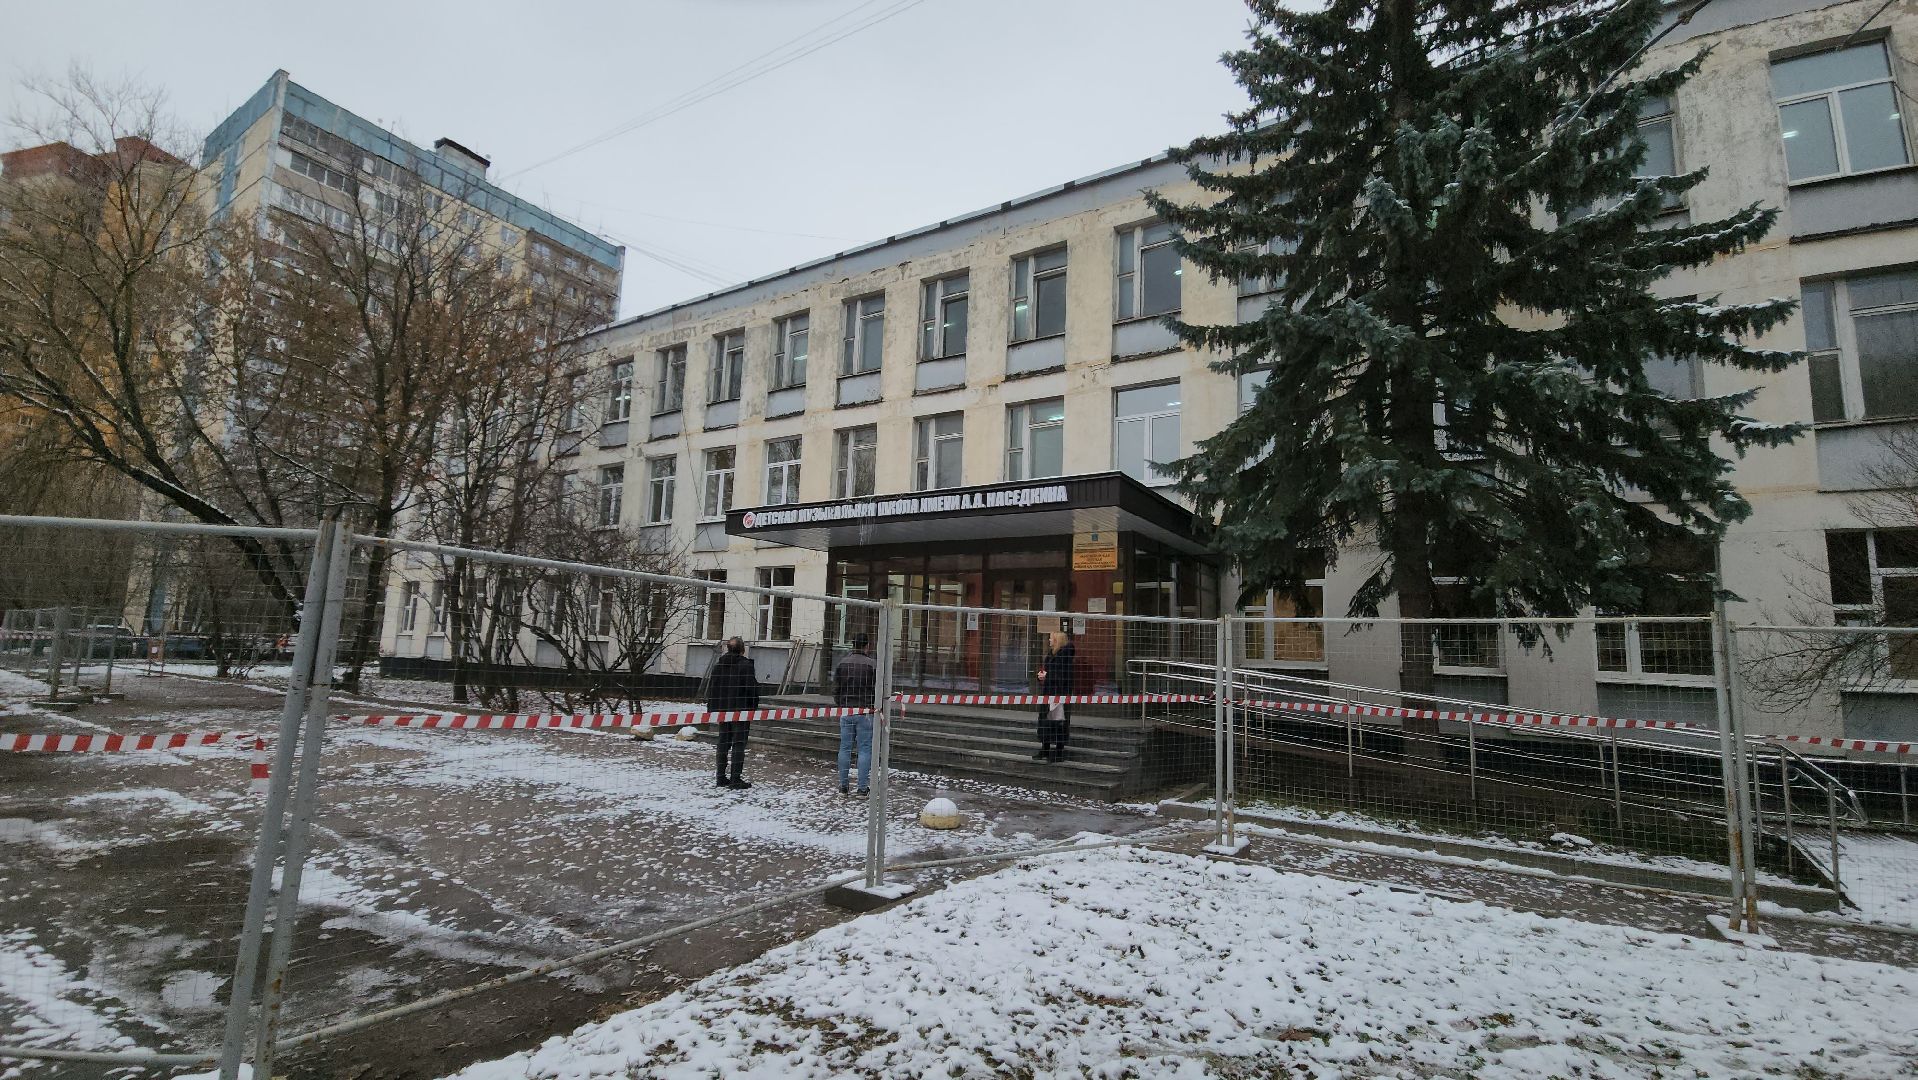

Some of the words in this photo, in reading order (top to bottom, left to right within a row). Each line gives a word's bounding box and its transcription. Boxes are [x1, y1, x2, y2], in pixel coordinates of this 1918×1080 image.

[755, 510, 799, 528] ДЕТСКАЯ
[799, 504, 877, 522] МУЗЫКАЛЬНАЯ
[877, 499, 919, 516] ШКОЛА
[920, 495, 960, 512] ИМЕНИ
[987, 485, 1068, 508] НАСЕДКИНА
